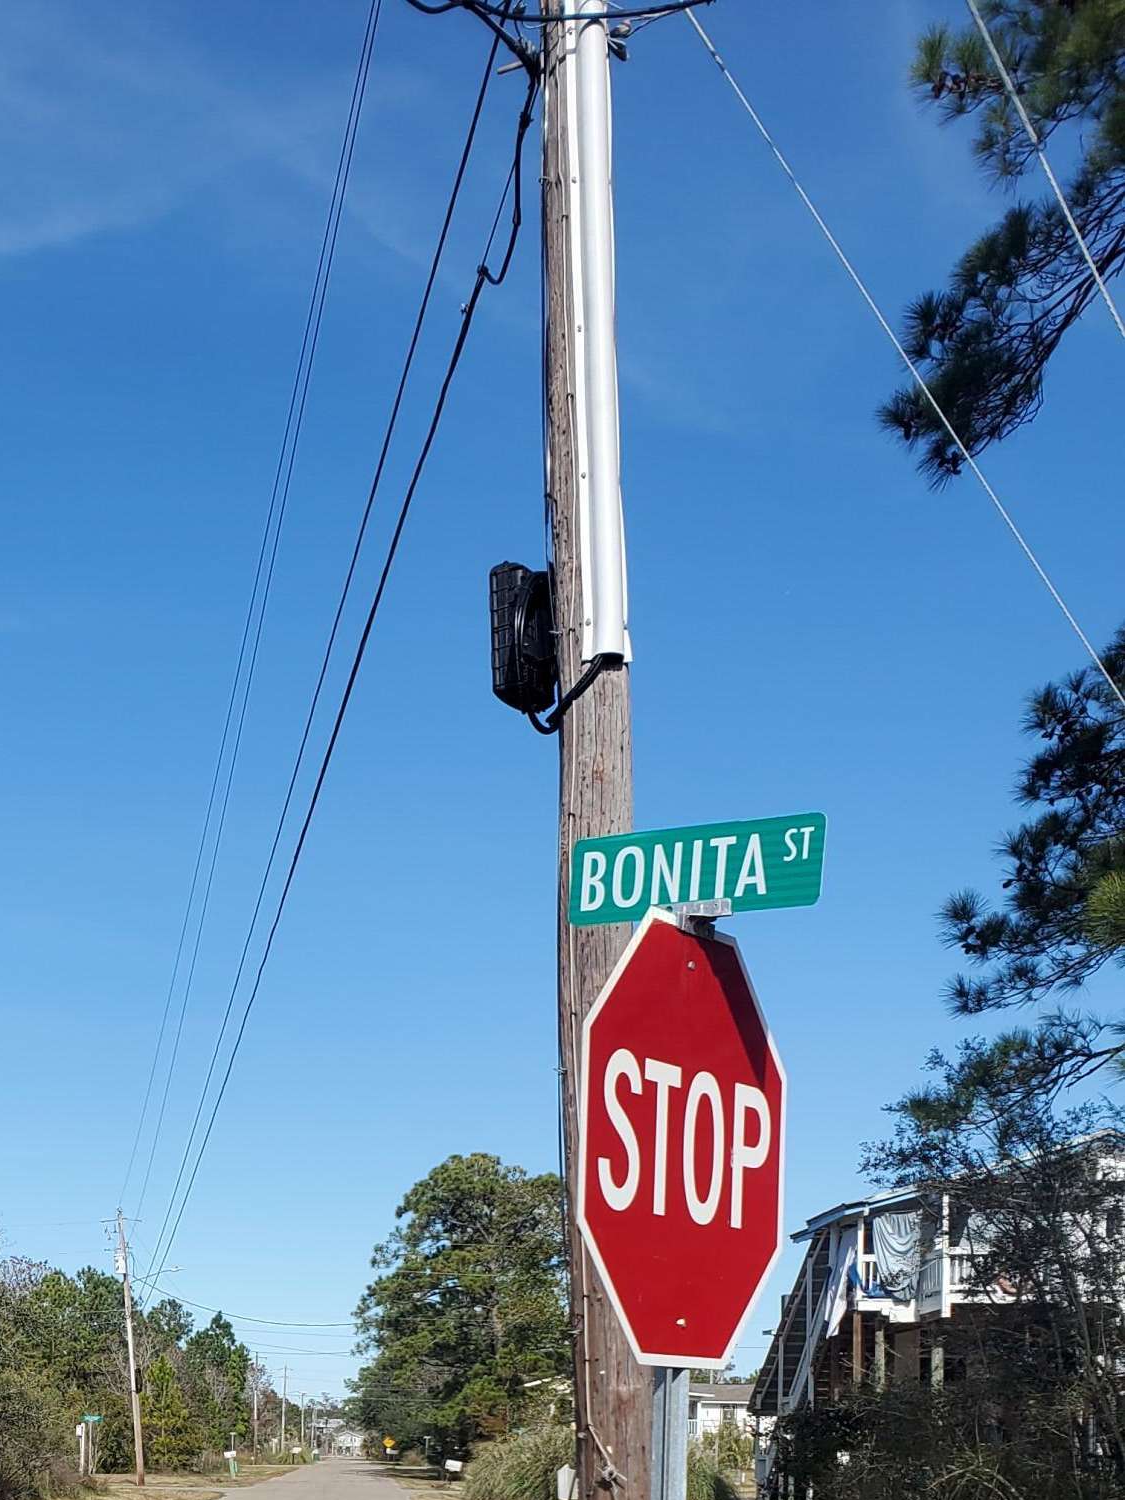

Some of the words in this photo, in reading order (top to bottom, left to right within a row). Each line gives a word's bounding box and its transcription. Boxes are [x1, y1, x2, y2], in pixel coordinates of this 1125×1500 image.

[580, 833, 767, 912] BONITA
[783, 826, 815, 862] ST
[597, 1048, 772, 1230] STOP
